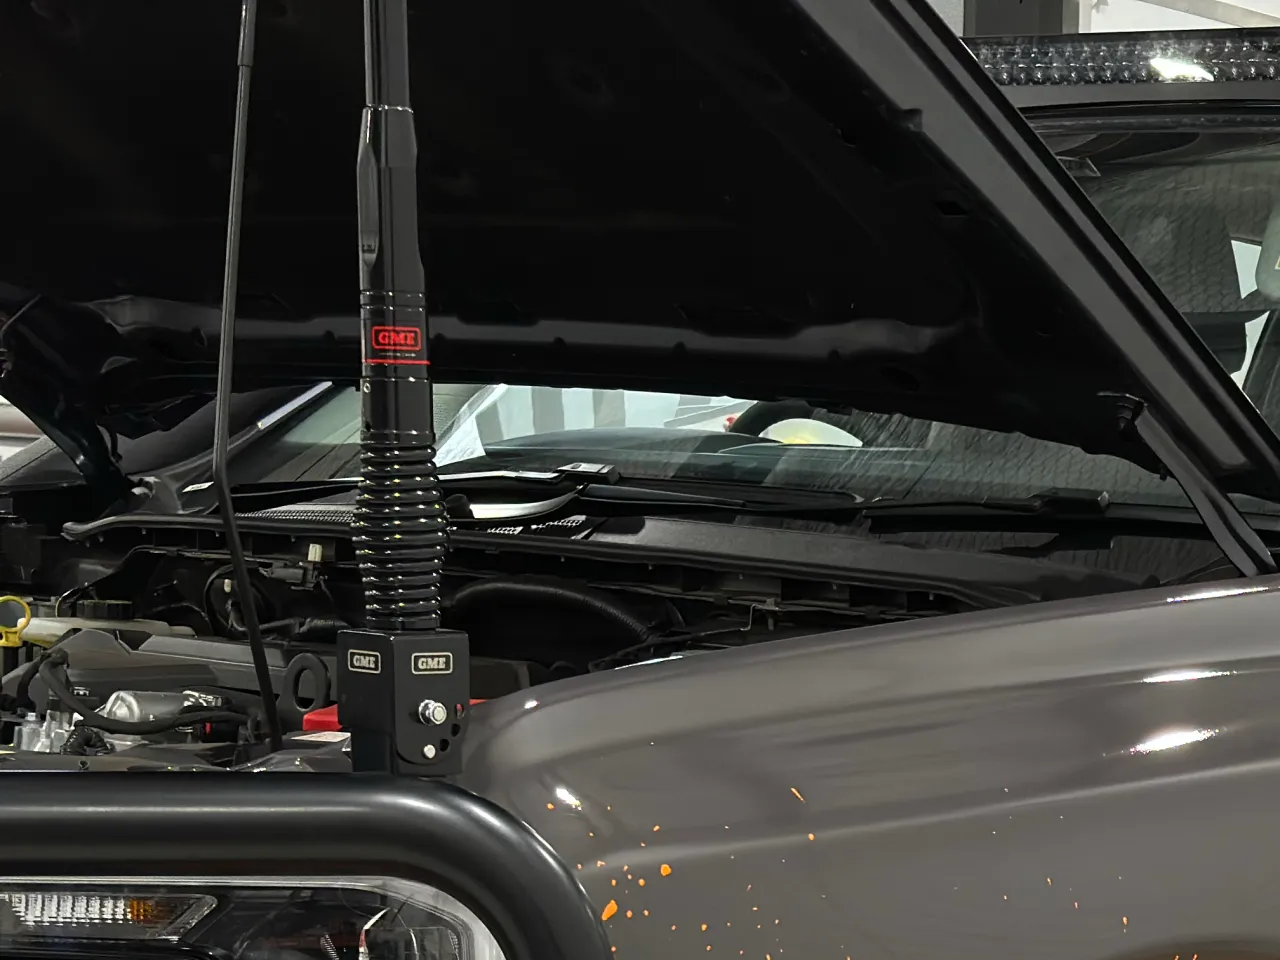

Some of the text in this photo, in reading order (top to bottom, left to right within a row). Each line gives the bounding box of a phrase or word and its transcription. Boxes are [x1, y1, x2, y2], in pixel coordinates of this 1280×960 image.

[378, 331, 415, 345] GME
[353, 655, 376, 668] GME
[418, 657, 446, 669] GME
